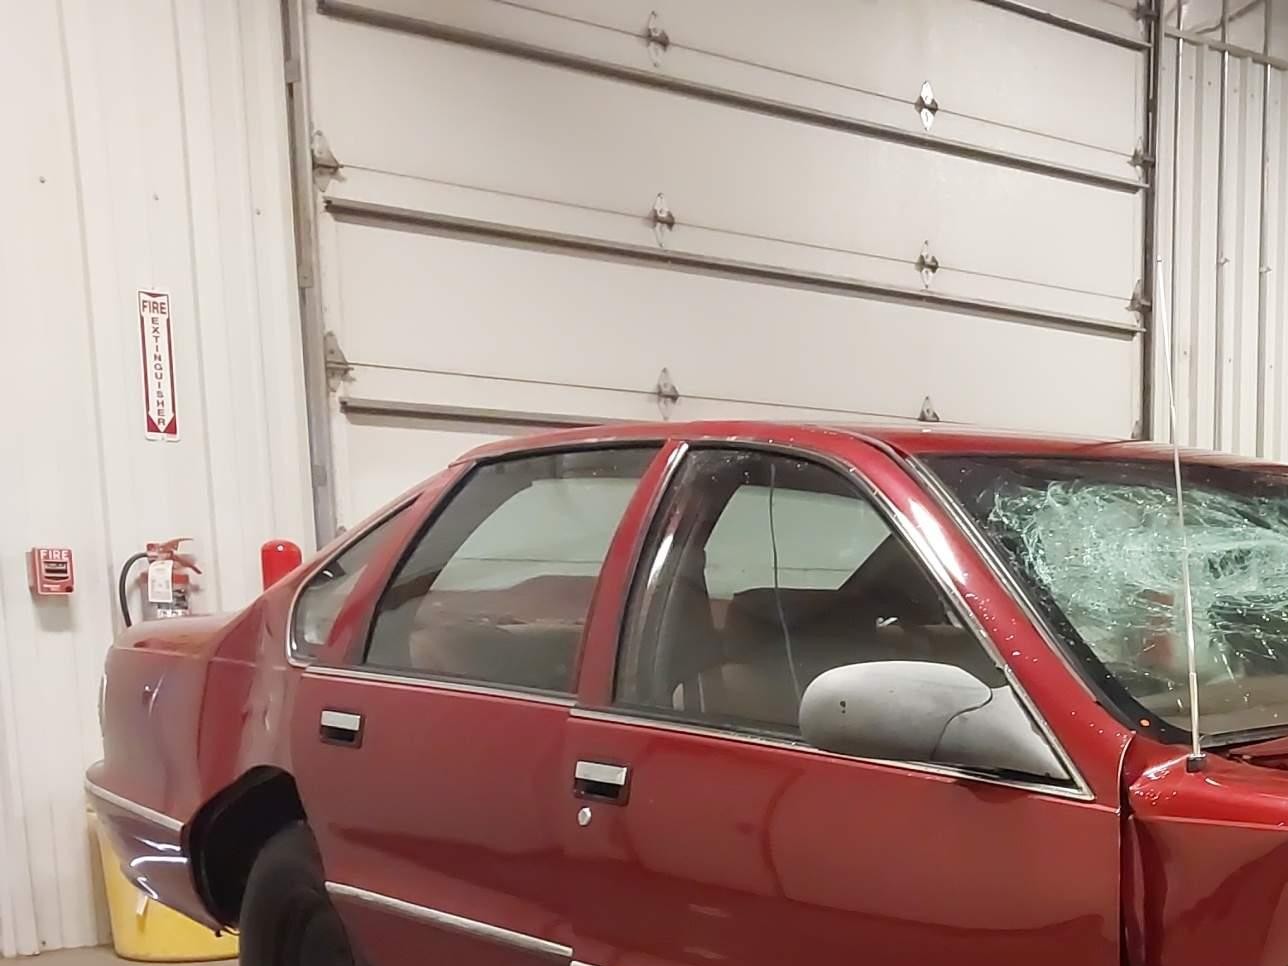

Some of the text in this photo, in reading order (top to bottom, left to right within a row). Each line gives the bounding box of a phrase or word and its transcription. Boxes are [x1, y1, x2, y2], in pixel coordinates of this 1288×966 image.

[141, 299, 167, 315] FIRE
[151, 316, 166, 426] EXTINGUISHER
[39, 549, 70, 561] FIRE
